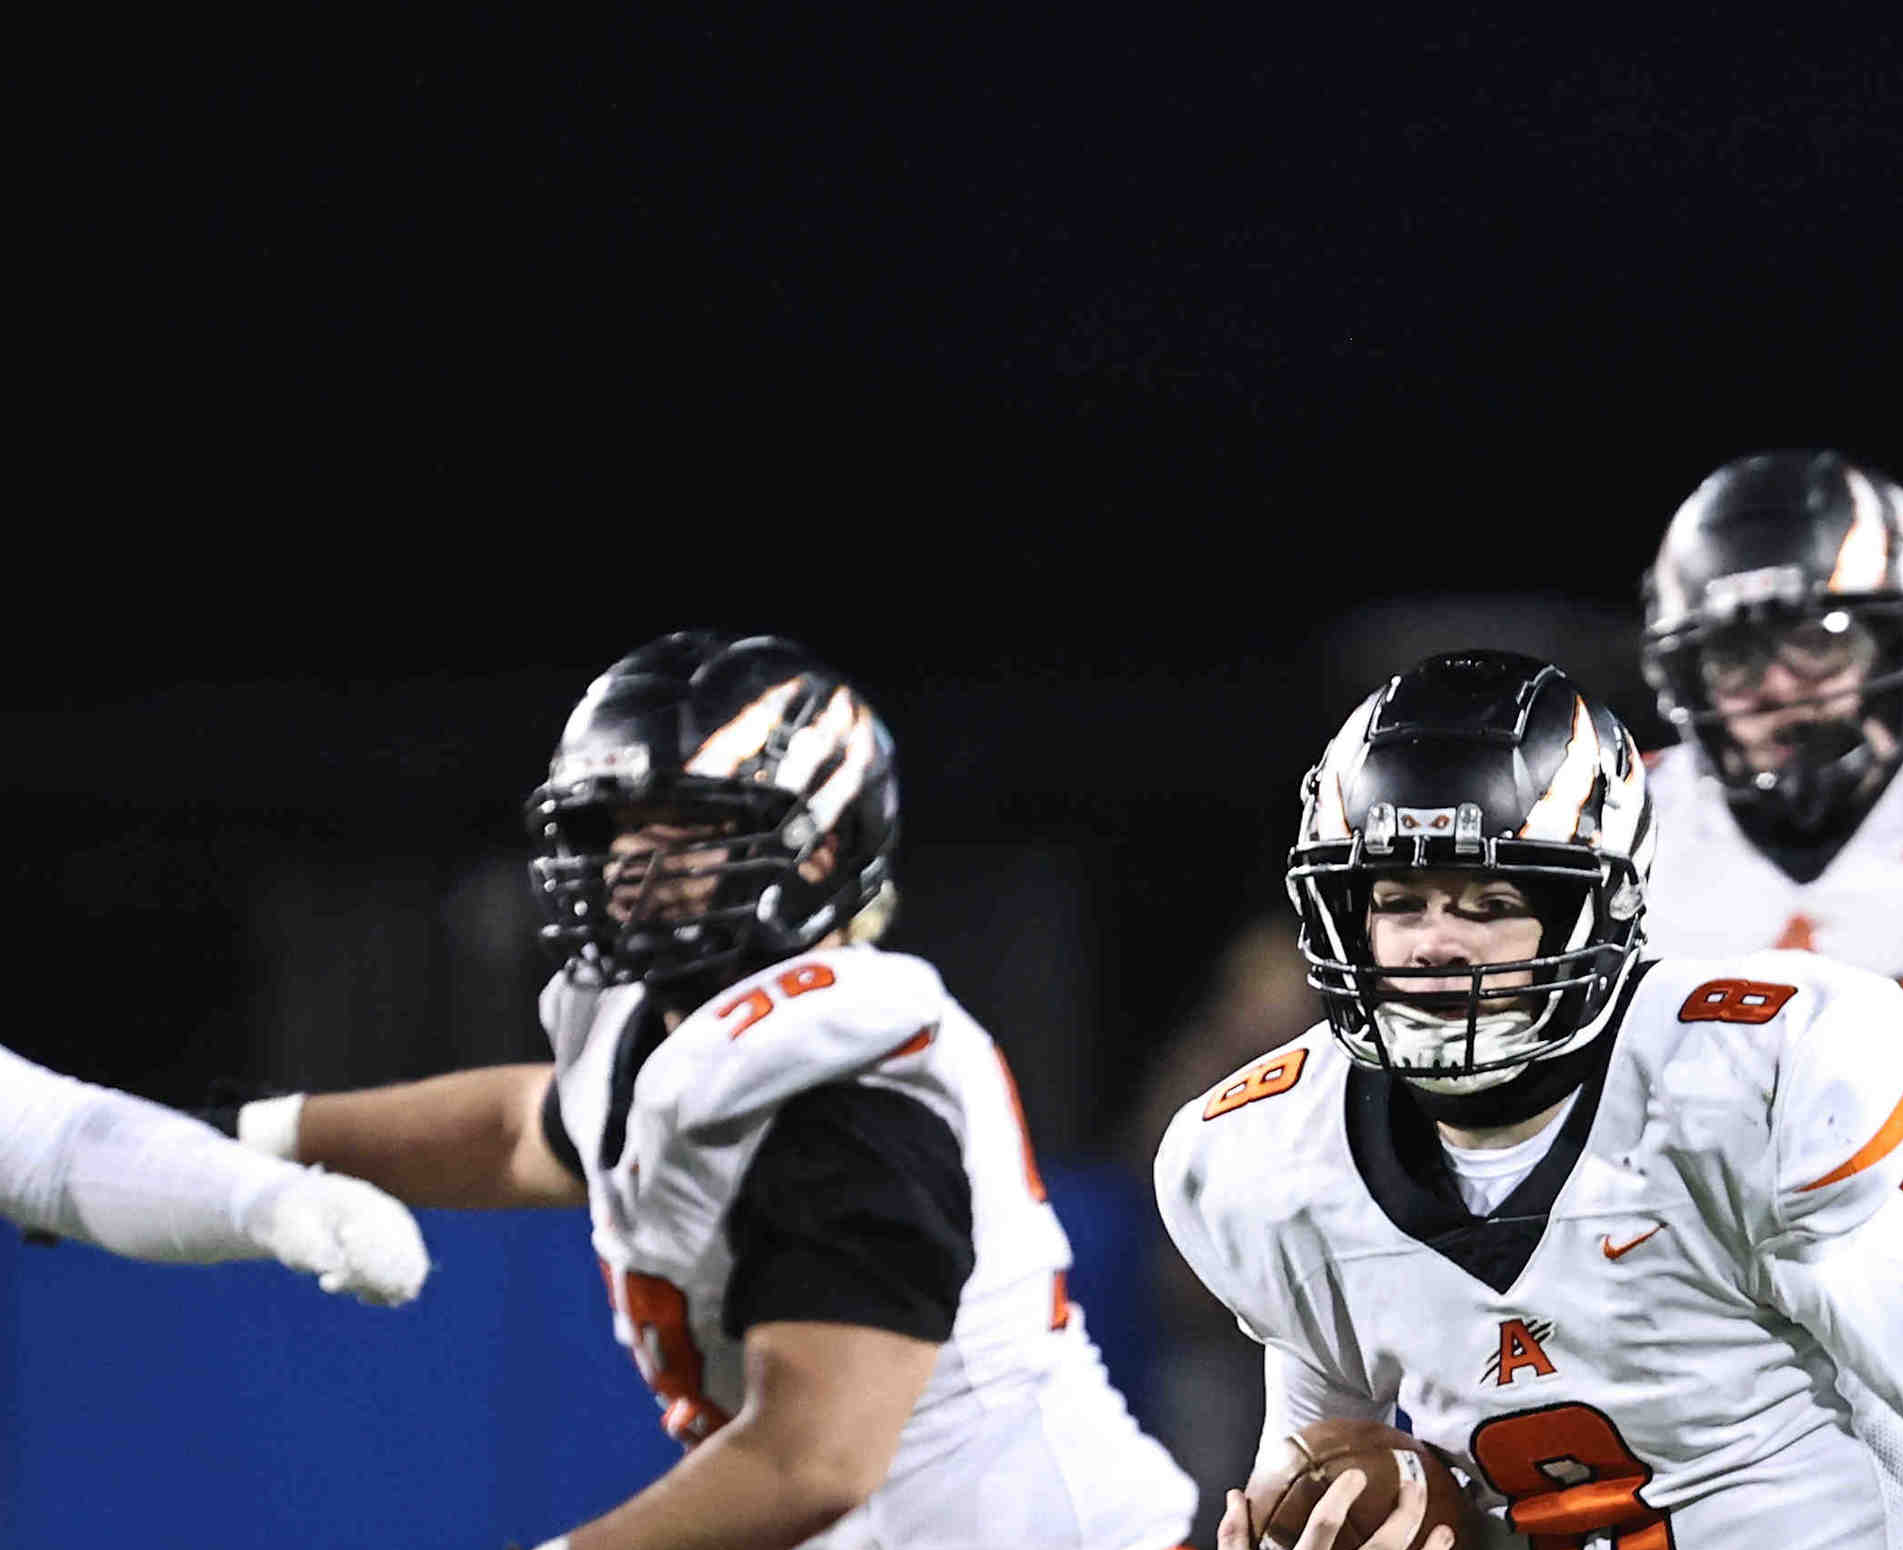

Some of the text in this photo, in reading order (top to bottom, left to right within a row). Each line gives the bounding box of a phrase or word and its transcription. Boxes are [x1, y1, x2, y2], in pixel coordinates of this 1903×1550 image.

[1677, 977, 1798, 1024] 8
[1202, 1048, 1309, 1121] 8
[1496, 1315, 1558, 1387] A
